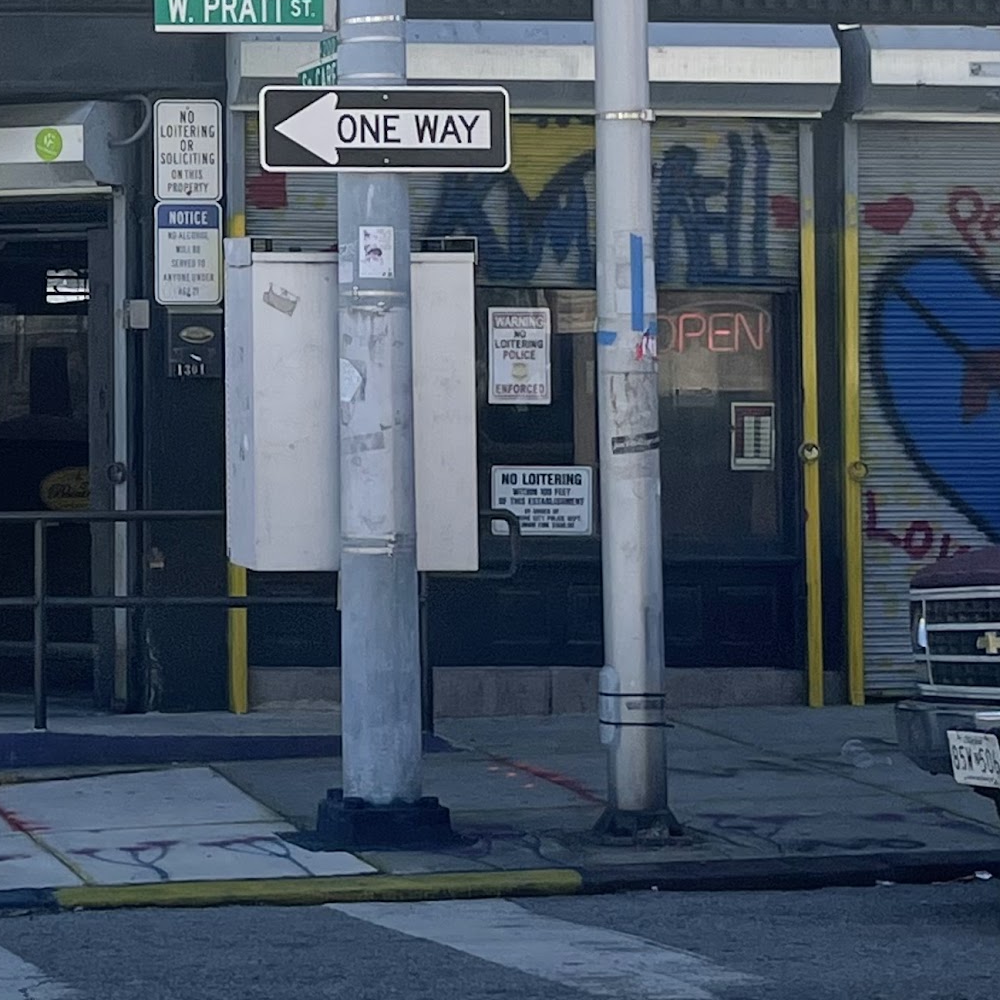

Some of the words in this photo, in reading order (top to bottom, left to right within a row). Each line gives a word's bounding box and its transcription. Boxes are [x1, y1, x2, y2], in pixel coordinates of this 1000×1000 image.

[290, 0, 315, 17] ST.
[180, 110, 194, 124] NO
[160, 125, 215, 138] LOITERING
[337, 114, 401, 144] ONE
[415, 115, 480, 144] WAY
[180, 139, 194, 152] OR
[160, 153, 215, 165] SOLICITING
[167, 182, 209, 193] PROPERTY
[168, 210, 208, 225] NOTICE
[495, 316, 544, 328] WARNING
[514, 329, 527, 338] NO
[657, 313, 763, 352] OPEN
[495, 340, 544, 349] LOITERING
[503, 350, 536, 360] POLICE
[495, 384, 545, 394] ENFORCED
[501, 473, 517, 485] NO
[522, 473, 582, 486] LOITERING
